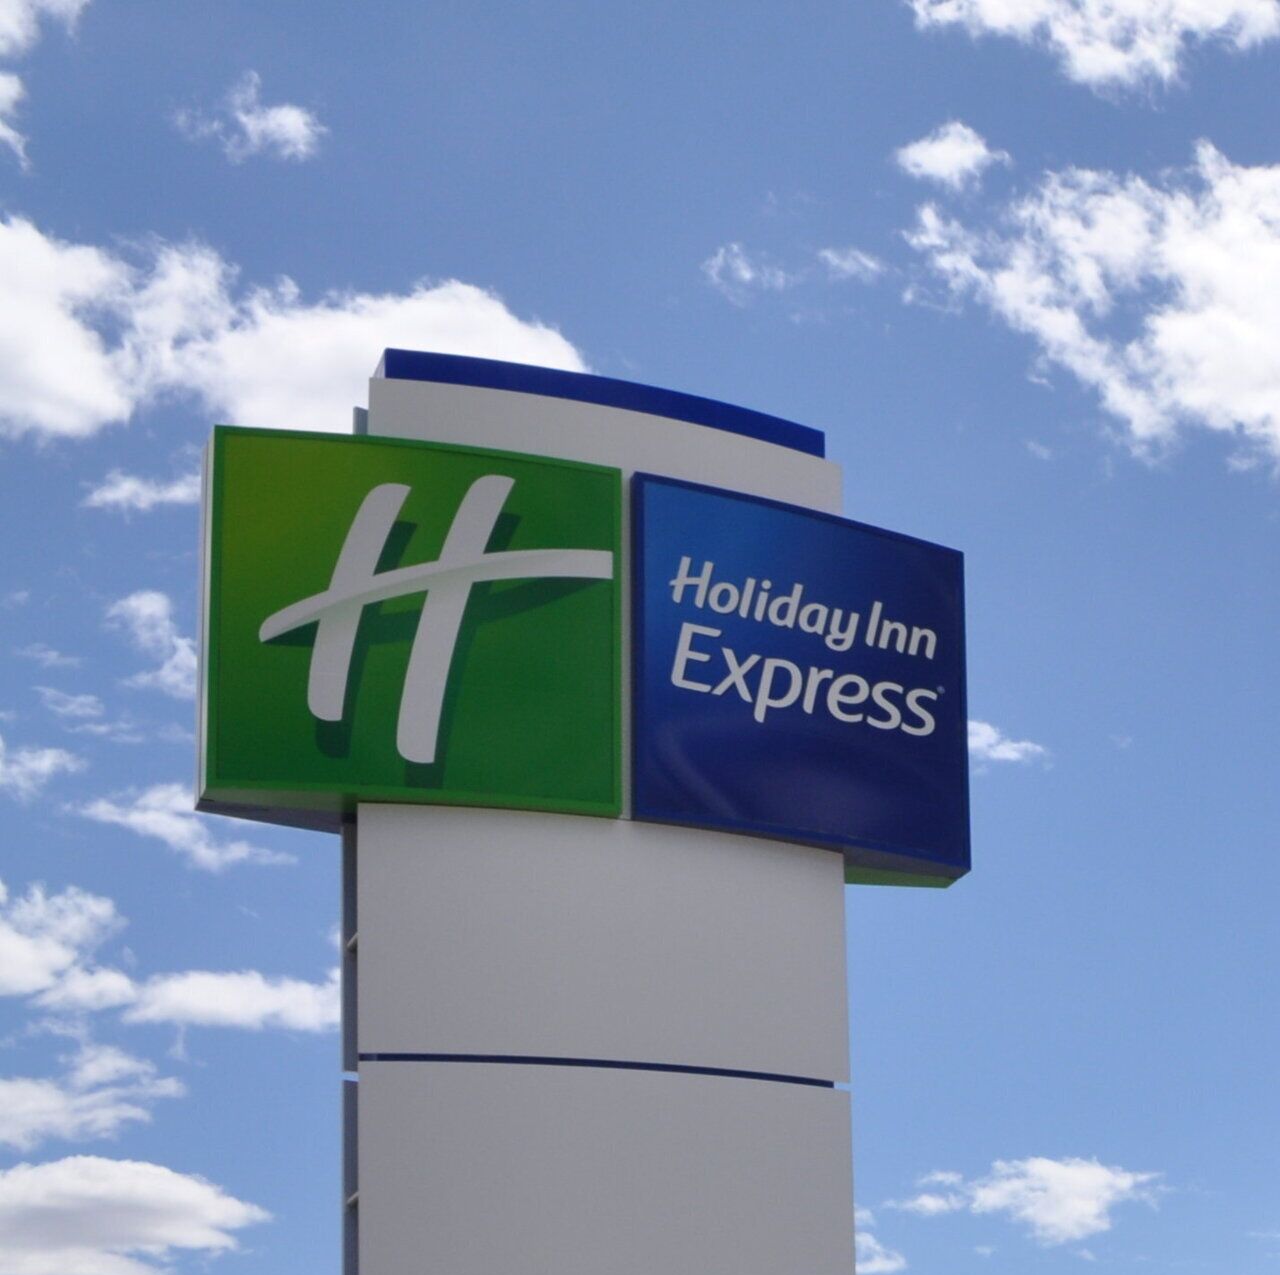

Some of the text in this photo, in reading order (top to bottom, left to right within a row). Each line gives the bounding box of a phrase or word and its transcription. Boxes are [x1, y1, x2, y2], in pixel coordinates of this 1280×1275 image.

[669, 556, 937, 660] Holiday Inn
[670, 622, 938, 737] Express
